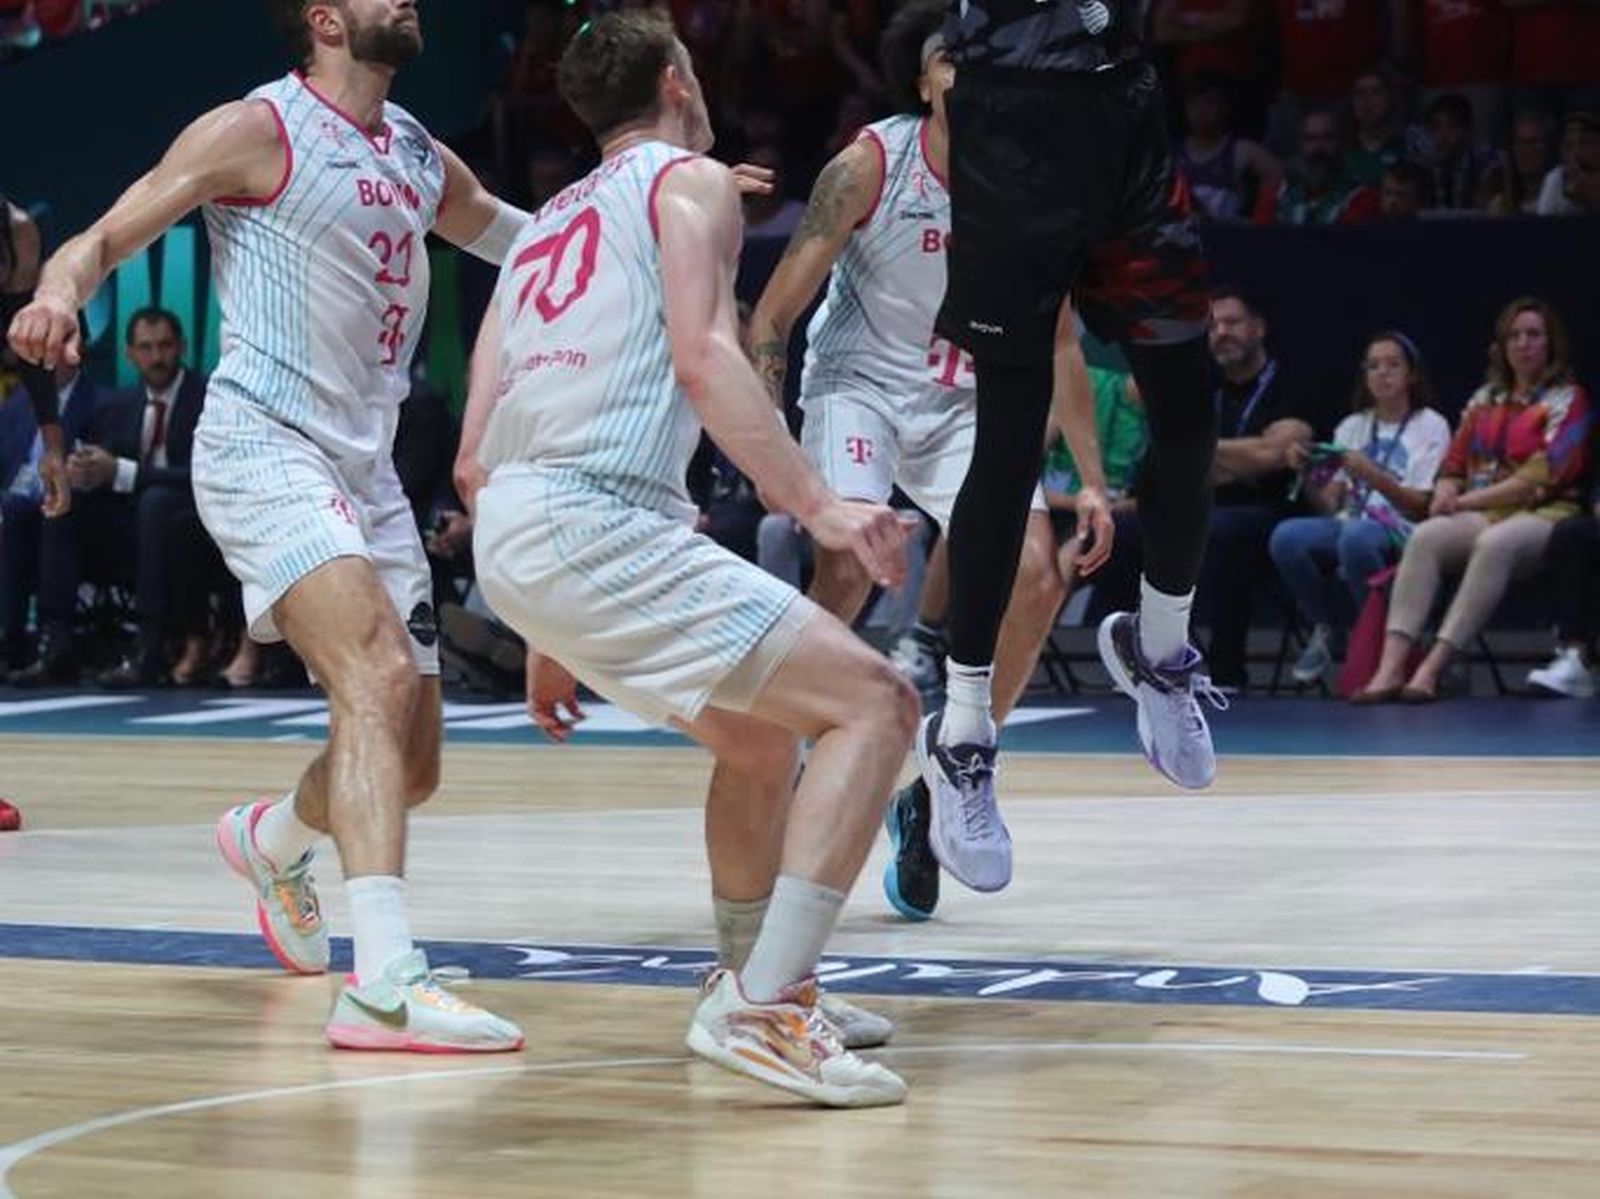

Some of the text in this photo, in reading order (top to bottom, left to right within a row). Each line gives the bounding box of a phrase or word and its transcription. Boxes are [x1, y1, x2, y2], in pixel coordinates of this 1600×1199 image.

[368, 230, 414, 287] 21
[511, 205, 600, 325] 70
[505, 944, 1450, 1005] Andalía
